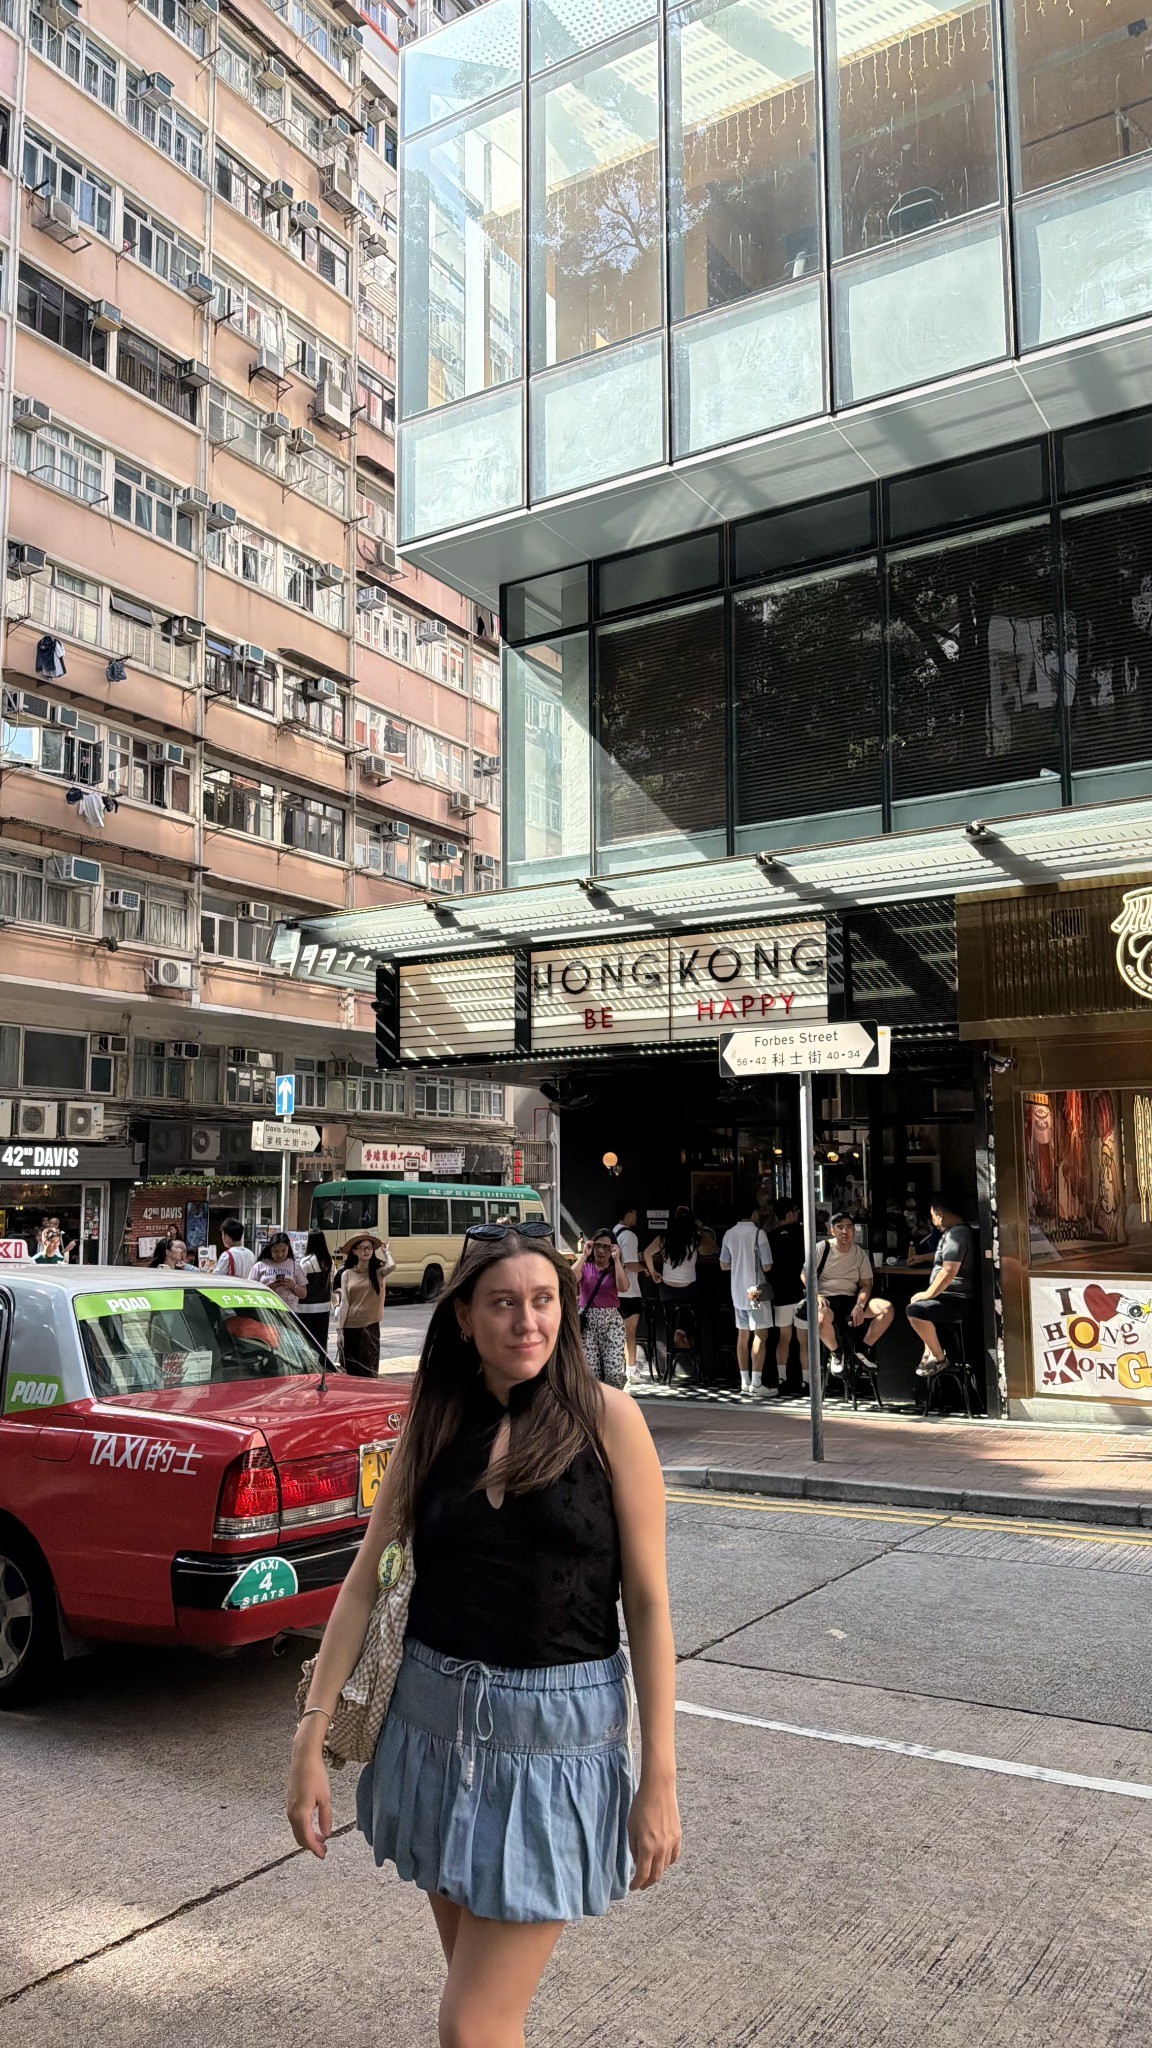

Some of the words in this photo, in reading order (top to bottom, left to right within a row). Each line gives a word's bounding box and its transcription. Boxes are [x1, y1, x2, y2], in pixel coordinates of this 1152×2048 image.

[533, 952, 662, 998] HONG
[679, 938, 826, 987] KONG
[584, 1007, 614, 1030] BE
[697, 991, 796, 1022] HAPPY
[754, 1036, 795, 1047] Forbes
[799, 1030, 839, 1044] Street
[772, 1050, 822, 1067] 科士街
[265, 1124, 281, 1133] Davis
[283, 1126, 301, 1135] Street
[1, 1146, 34, 1167] 42ND
[34, 1146, 79, 1168] DAVIS
[20, 1168, 40, 1176] HONG
[41, 1168, 61, 1176] KONG
[160, 1206, 183, 1219] DAVIS
[0, 1241, 23, 1258] XI
[106, 1296, 151, 1313] POAD
[1055, 1287, 1077, 1316] I
[10, 1380, 59, 1406] POAD
[252, 1559, 279, 1575] TAXI
[258, 1571, 273, 1591] 4
[242, 1587, 285, 1606] SEATS
